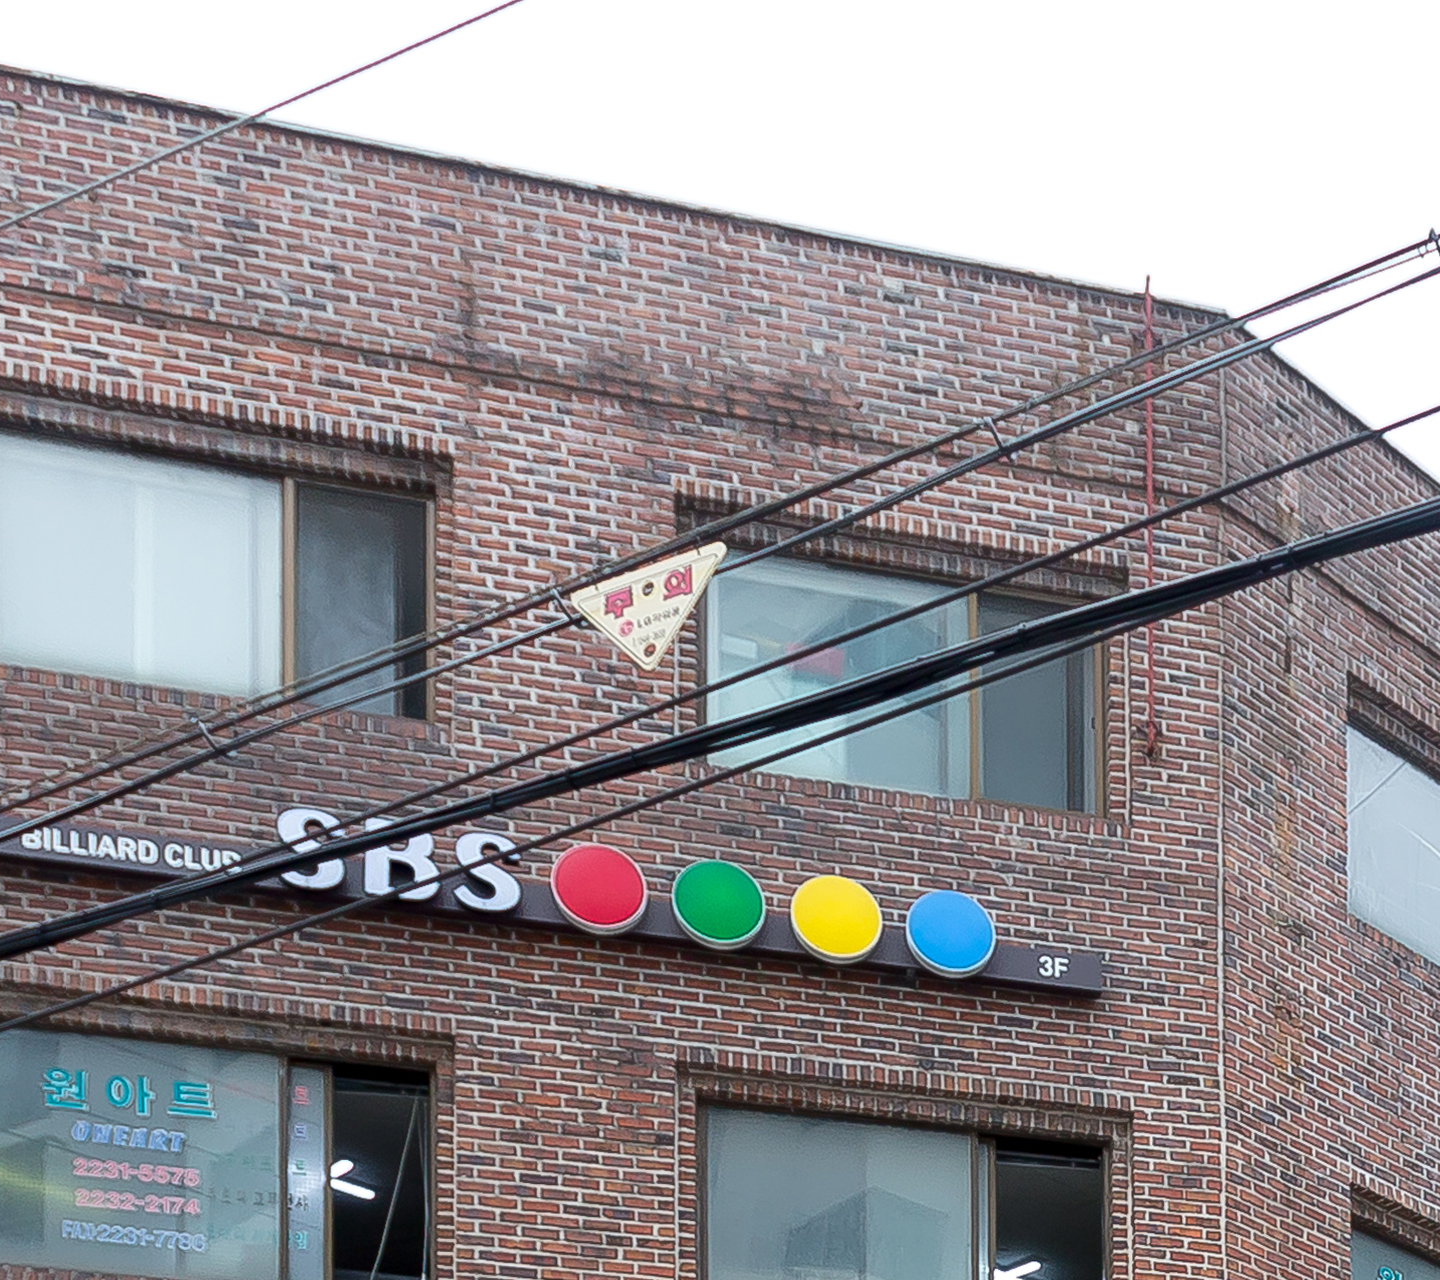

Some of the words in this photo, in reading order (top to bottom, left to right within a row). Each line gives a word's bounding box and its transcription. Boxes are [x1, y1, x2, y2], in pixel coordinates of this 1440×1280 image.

[22, 829, 158, 865] BILLIARD
[277, 807, 522, 912] SBS
[1037, 953, 1070, 980] 3F
[42, 1067, 218, 1120] 원아트
[71, 1120, 187, 1153] ONEART
[72, 1157, 200, 1188] 2231-5575
[75, 1189, 200, 1216] 2232-2174
